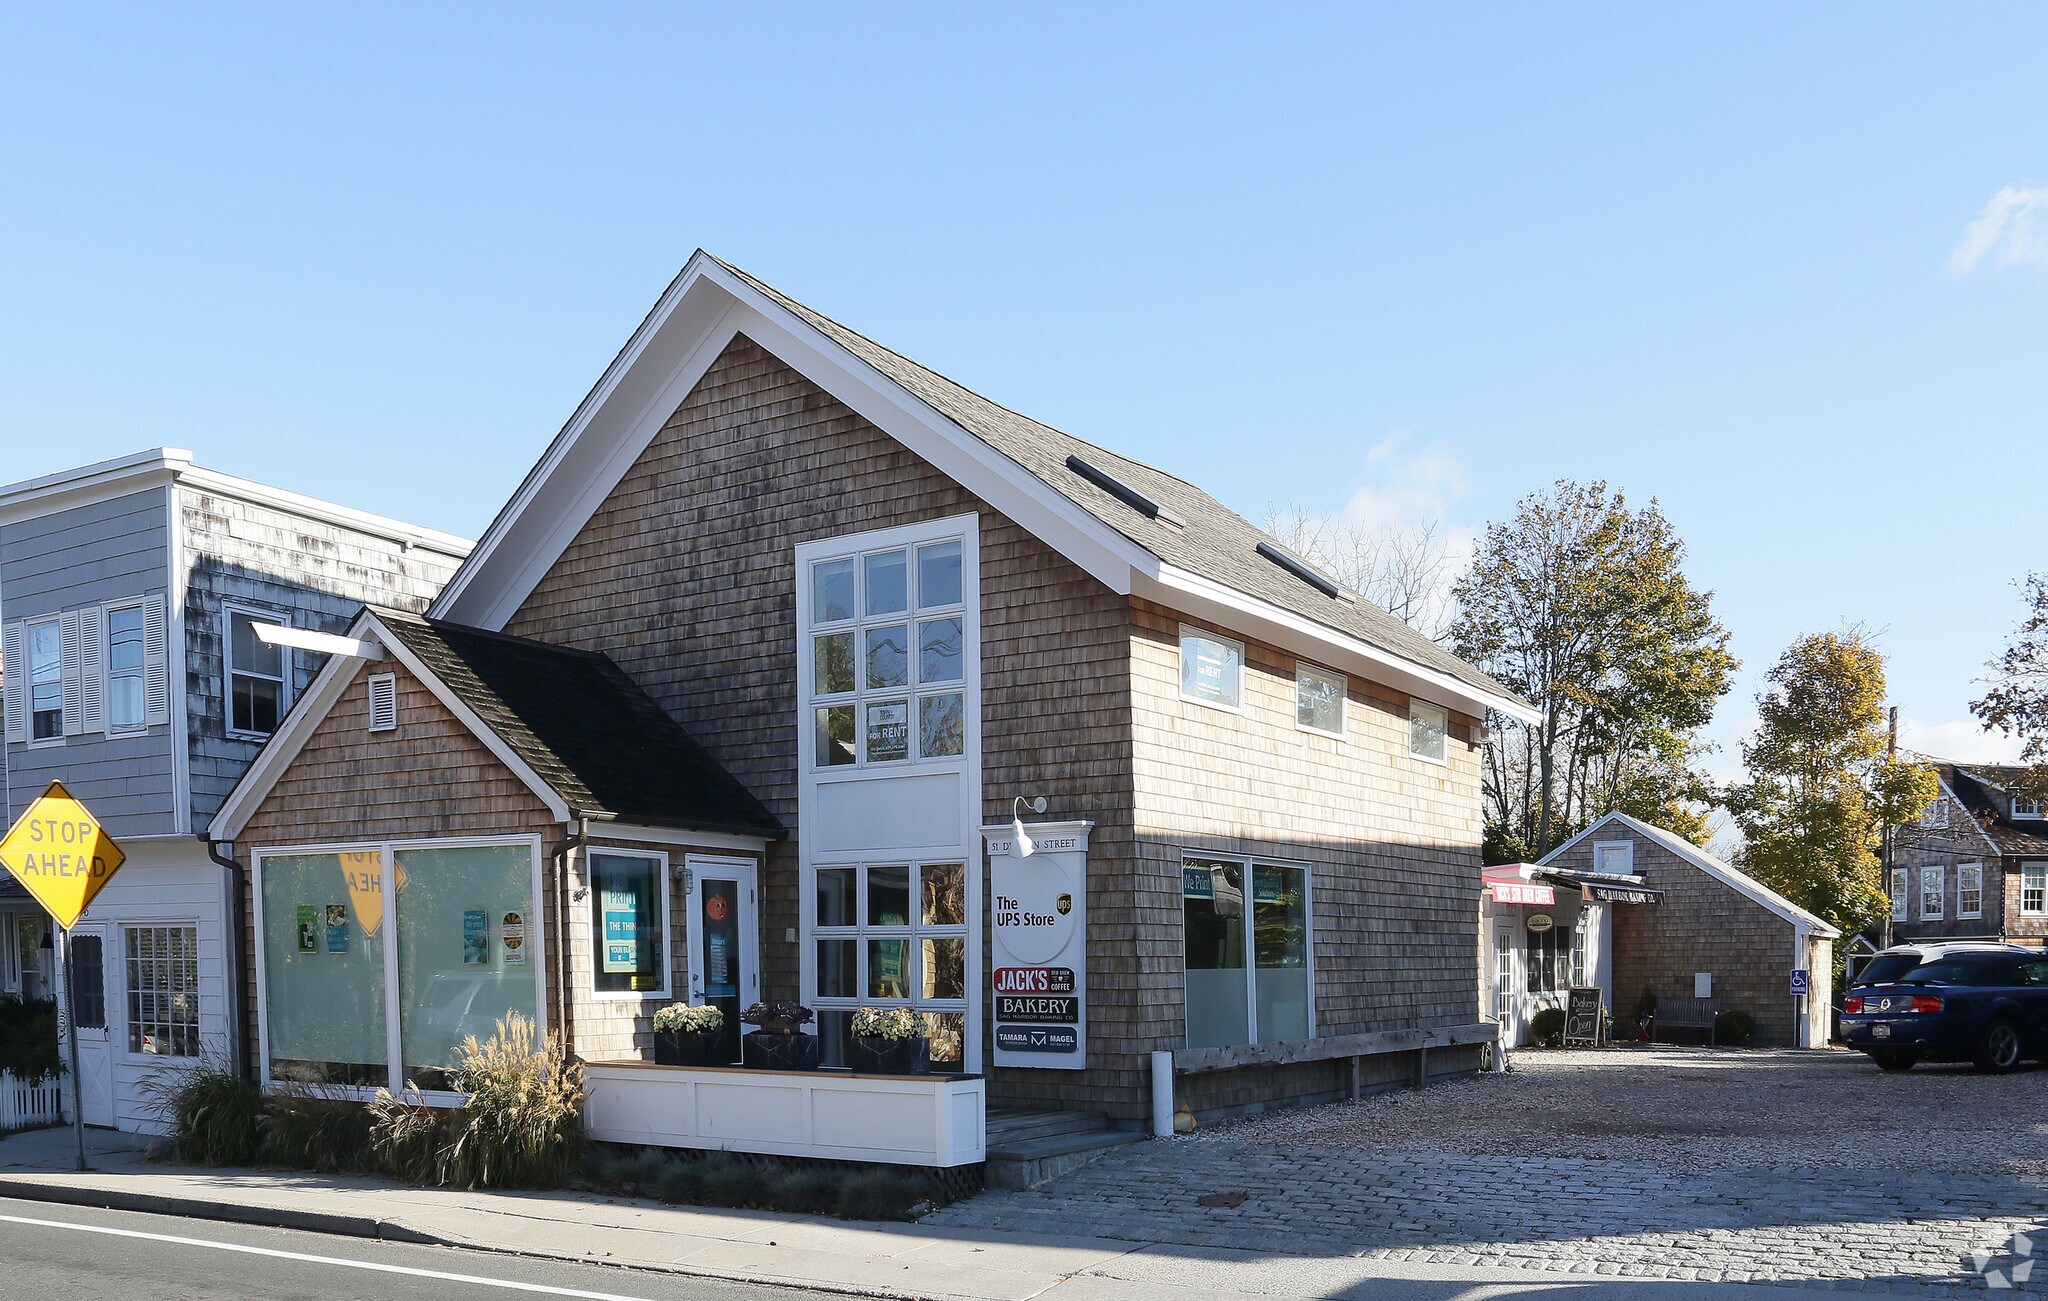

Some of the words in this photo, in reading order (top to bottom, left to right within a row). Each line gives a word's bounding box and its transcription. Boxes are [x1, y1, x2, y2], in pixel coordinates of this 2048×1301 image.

[1205, 665, 1222, 680] RENT
[882, 726, 907, 738] RENT
[30, 819, 92, 844] STOP
[992, 842, 998, 851] 51
[1043, 839, 1077, 849] STREET
[23, 853, 107, 878] AHEAD
[1184, 874, 1194, 889] We
[1597, 889, 1607, 900] SAG
[996, 896, 1018, 910] The
[1057, 900, 1071, 912] ups
[609, 921, 621, 931] THE
[997, 912, 1020, 926] UPS
[1023, 912, 1055, 926] Store
[997, 969, 1048, 991] JACK'S
[1050, 983, 1070, 991] COFFEE
[1003, 998, 1070, 1014] BAKERY
[1572, 996, 1598, 1011] Bakery
[1568, 1016, 1592, 1034] Open
[999, 1033, 1028, 1042] TAMARA
[1050, 1035, 1074, 1043] MAGEL
